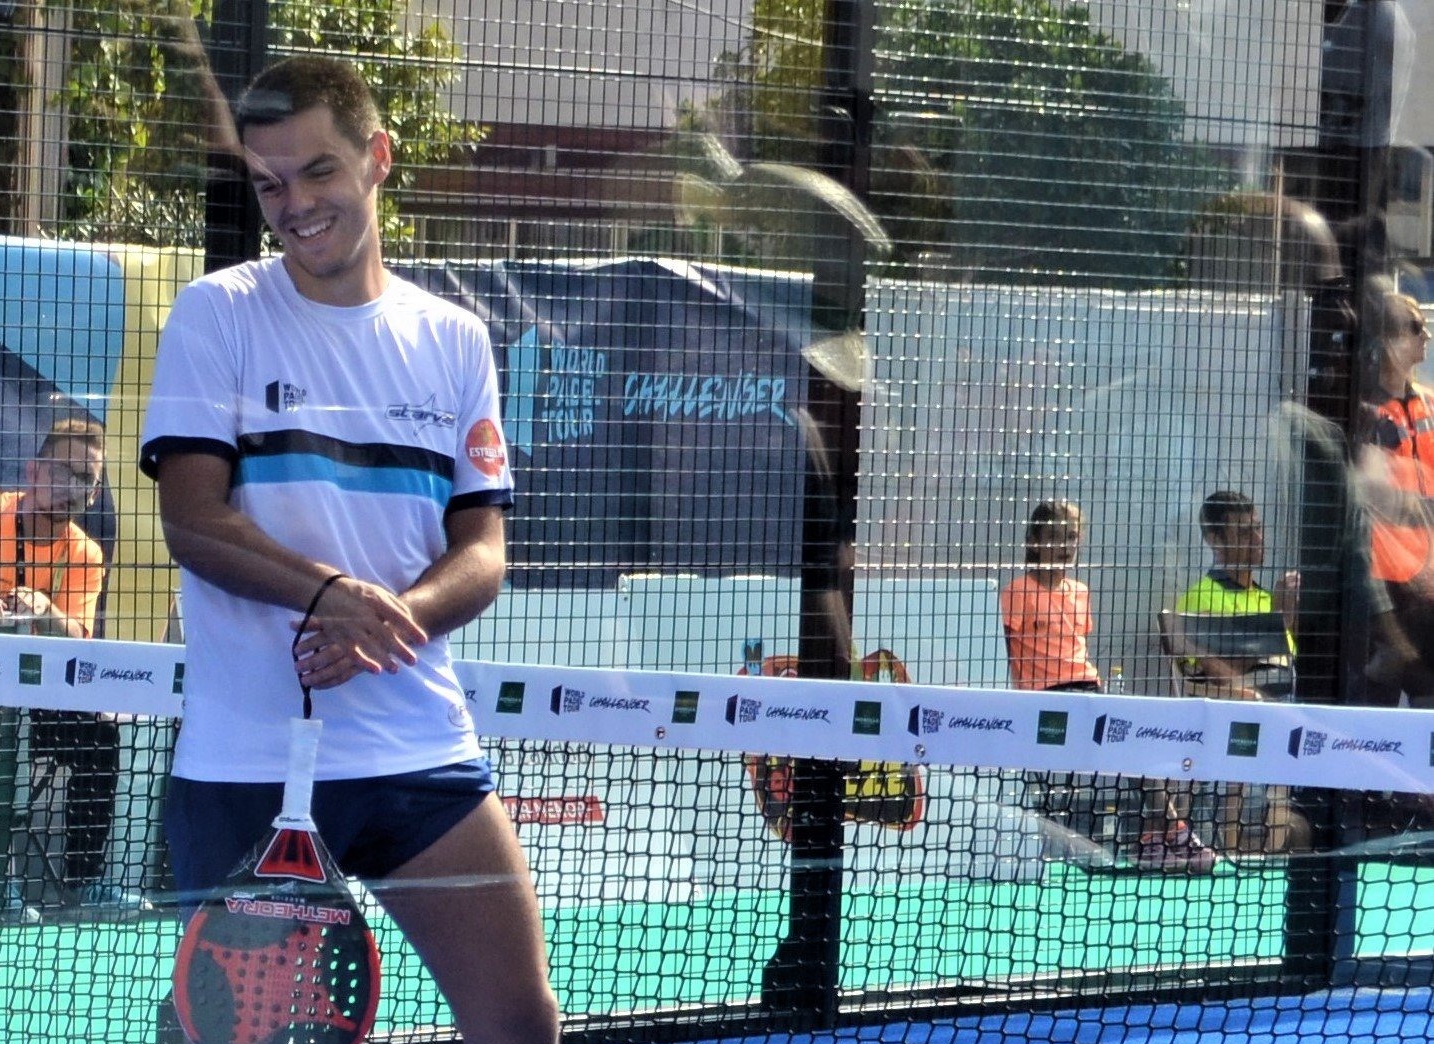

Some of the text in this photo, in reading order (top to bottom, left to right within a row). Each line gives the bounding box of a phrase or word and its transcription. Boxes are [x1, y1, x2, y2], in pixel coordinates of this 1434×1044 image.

[551, 338, 606, 378] WORLD
[623, 368, 797, 428] CHALLENGER
[541, 407, 593, 442] TOUR
[766, 705, 831, 724] CHALLENGER
[948, 716, 1015, 734] CHALLENGER
[1135, 726, 1204, 745] CHALLENGER
[224, 897, 351, 925] METHEORA
